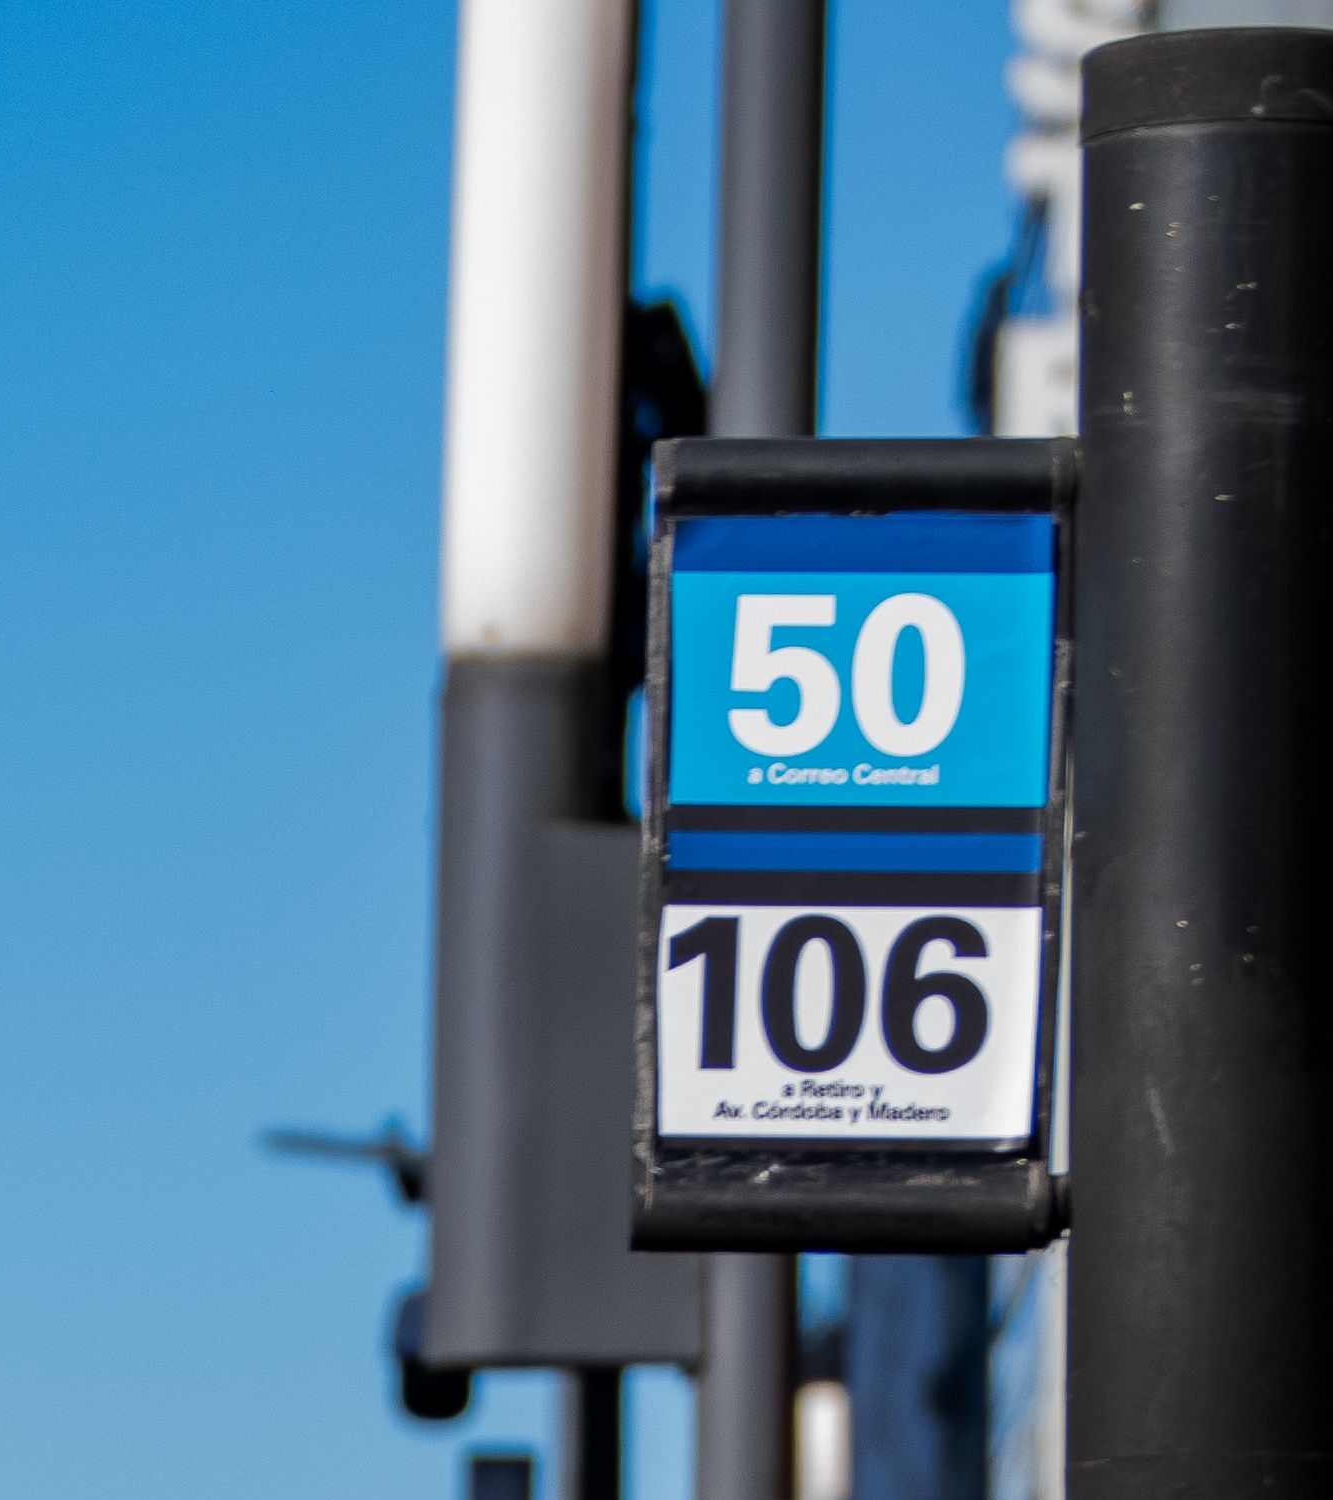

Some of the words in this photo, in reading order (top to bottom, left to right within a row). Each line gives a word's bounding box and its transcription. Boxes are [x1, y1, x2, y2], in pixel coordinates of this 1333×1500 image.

[728, 592, 966, 758] 50
[746, 766, 764, 786] a
[767, 762, 850, 786] Correo
[852, 762, 941, 786] Central
[667, 914, 991, 1075] 106
[800, 1078, 865, 1098] Retiro
[870, 1084, 884, 1106] y
[848, 1106, 862, 1125] y
[867, 1100, 951, 1121] Madero
